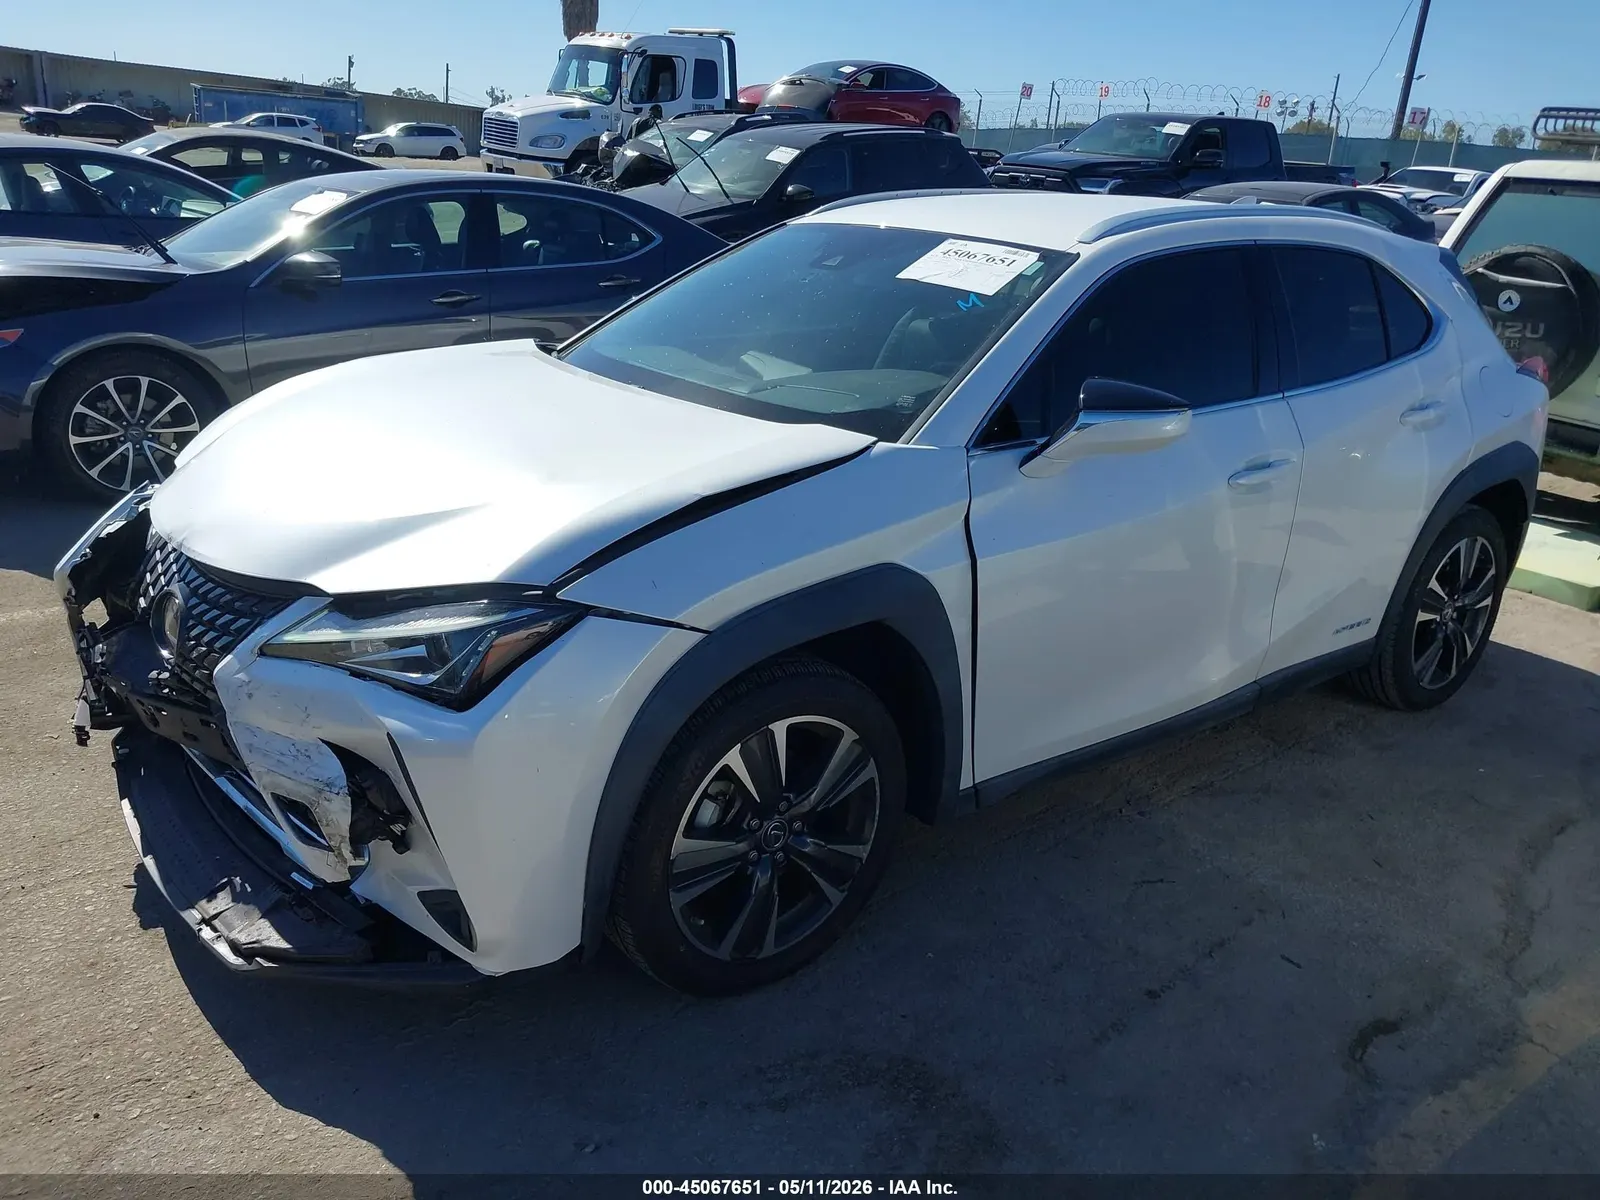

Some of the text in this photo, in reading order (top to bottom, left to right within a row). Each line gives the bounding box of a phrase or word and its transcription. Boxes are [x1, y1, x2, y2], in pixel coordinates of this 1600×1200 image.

[1021, 86, 1032, 97] 20
[1099, 86, 1109, 97] 19
[1257, 95, 1271, 108] 18
[1408, 111, 1426, 125] 17
[940, 248, 1017, 267] 45067651
